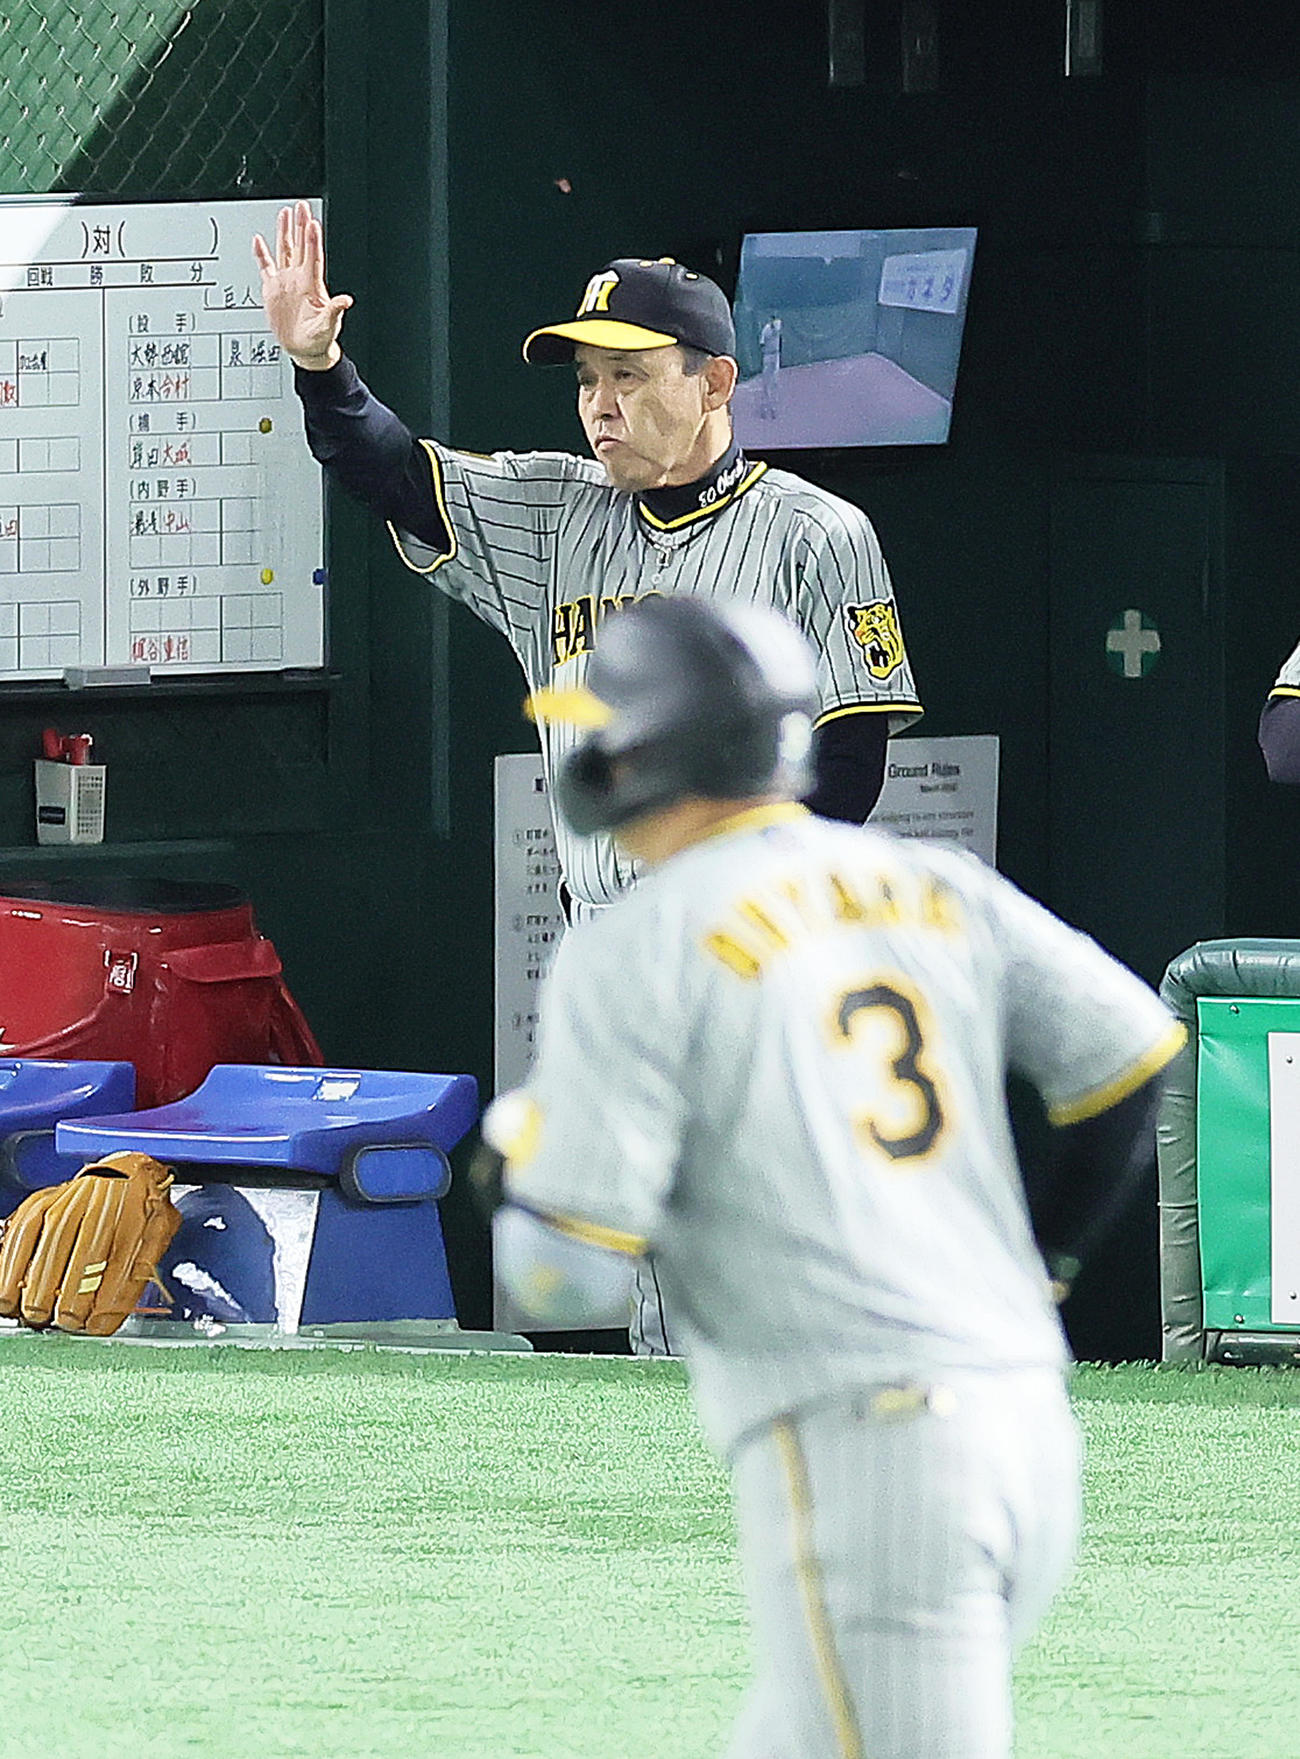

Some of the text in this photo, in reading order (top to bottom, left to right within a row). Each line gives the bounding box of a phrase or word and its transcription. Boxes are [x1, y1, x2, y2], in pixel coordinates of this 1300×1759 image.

[26, 262, 203, 287] 回戦 勝 敗 分
[834, 980, 945, 1163] 3
